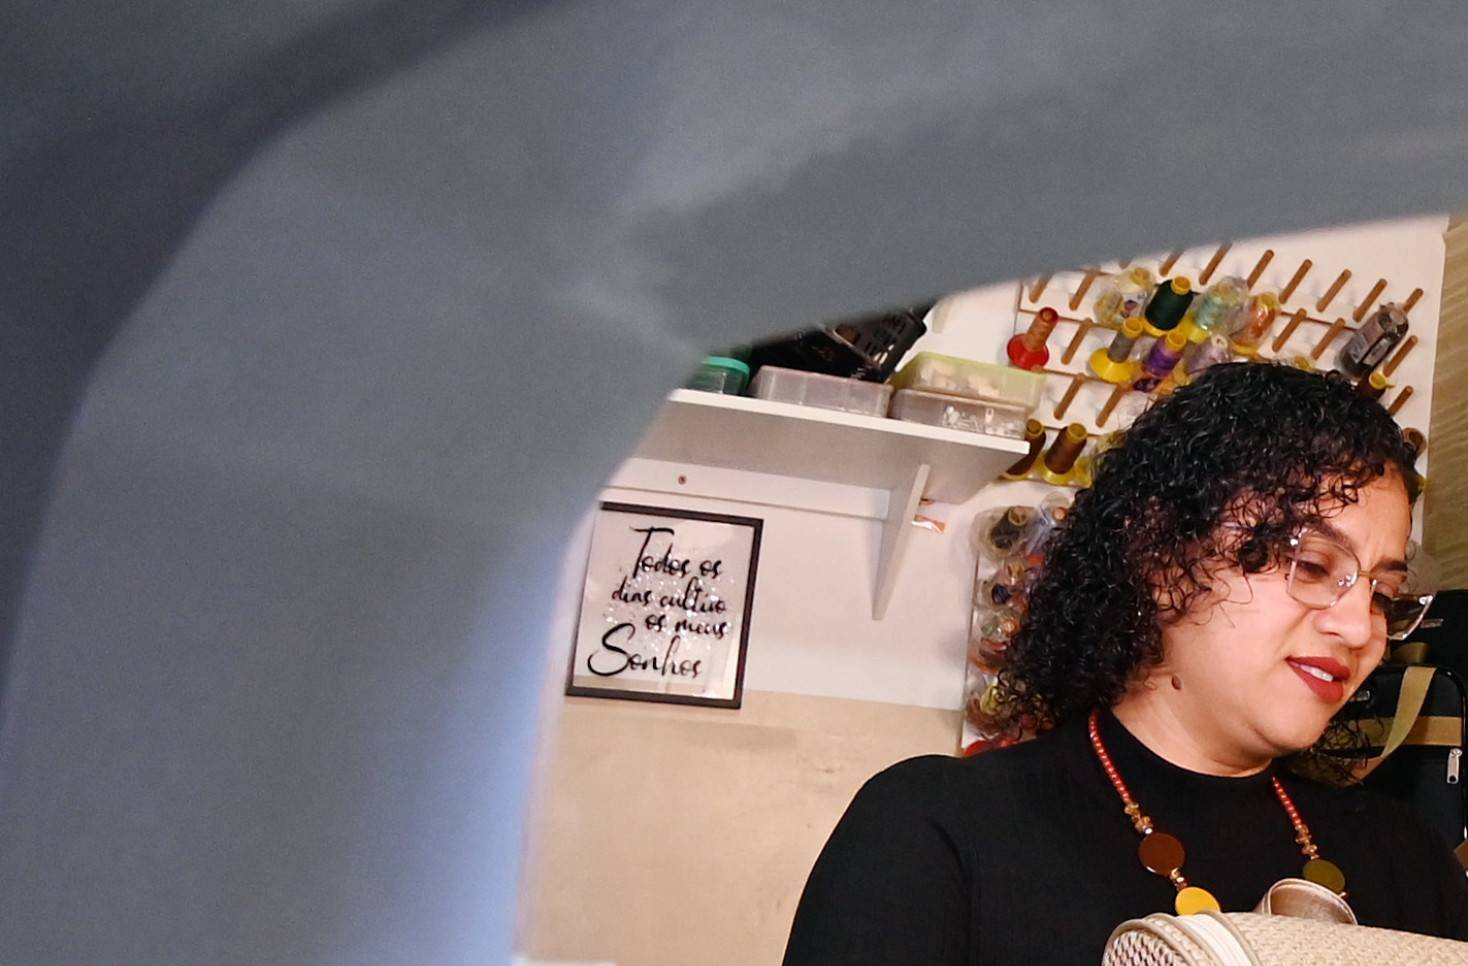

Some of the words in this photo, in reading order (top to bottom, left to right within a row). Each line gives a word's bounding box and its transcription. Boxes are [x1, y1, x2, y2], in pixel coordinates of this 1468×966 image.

[629, 526, 691, 578] Todos
[699, 560, 722, 579] os
[612, 575, 653, 606] dias
[659, 577, 727, 614] cultivo
[645, 614, 665, 633] os
[675, 620, 727, 639] meus
[587, 623, 702, 678] Sonhos
